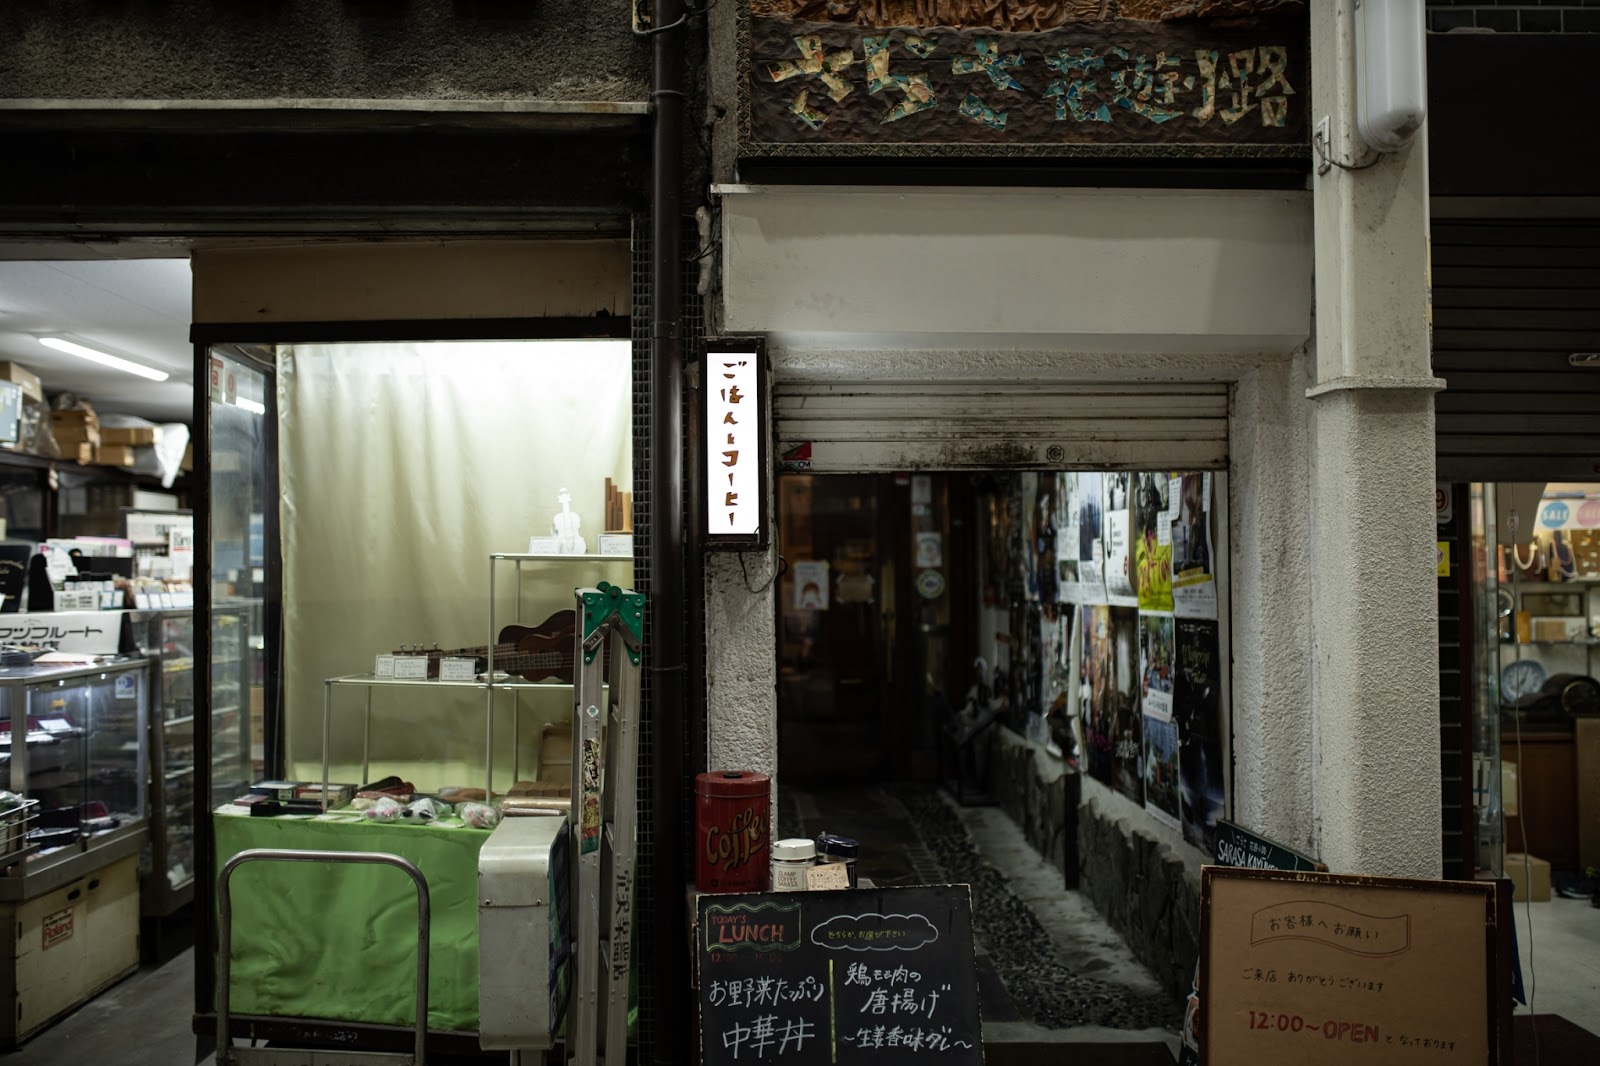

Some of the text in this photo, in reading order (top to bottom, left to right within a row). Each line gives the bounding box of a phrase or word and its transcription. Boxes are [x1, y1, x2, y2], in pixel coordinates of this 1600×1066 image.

[720, 360, 747, 526] ごはんとコーヒー
[1218, 839, 1246, 867] SARASA
[711, 914, 748, 925] TODAY'S
[719, 923, 785, 943] LUNCH
[709, 975, 825, 1008] お野菜たっぷり
[860, 984, 951, 1019] 唐揚げ
[722, 1013, 816, 1060] 中華丼
